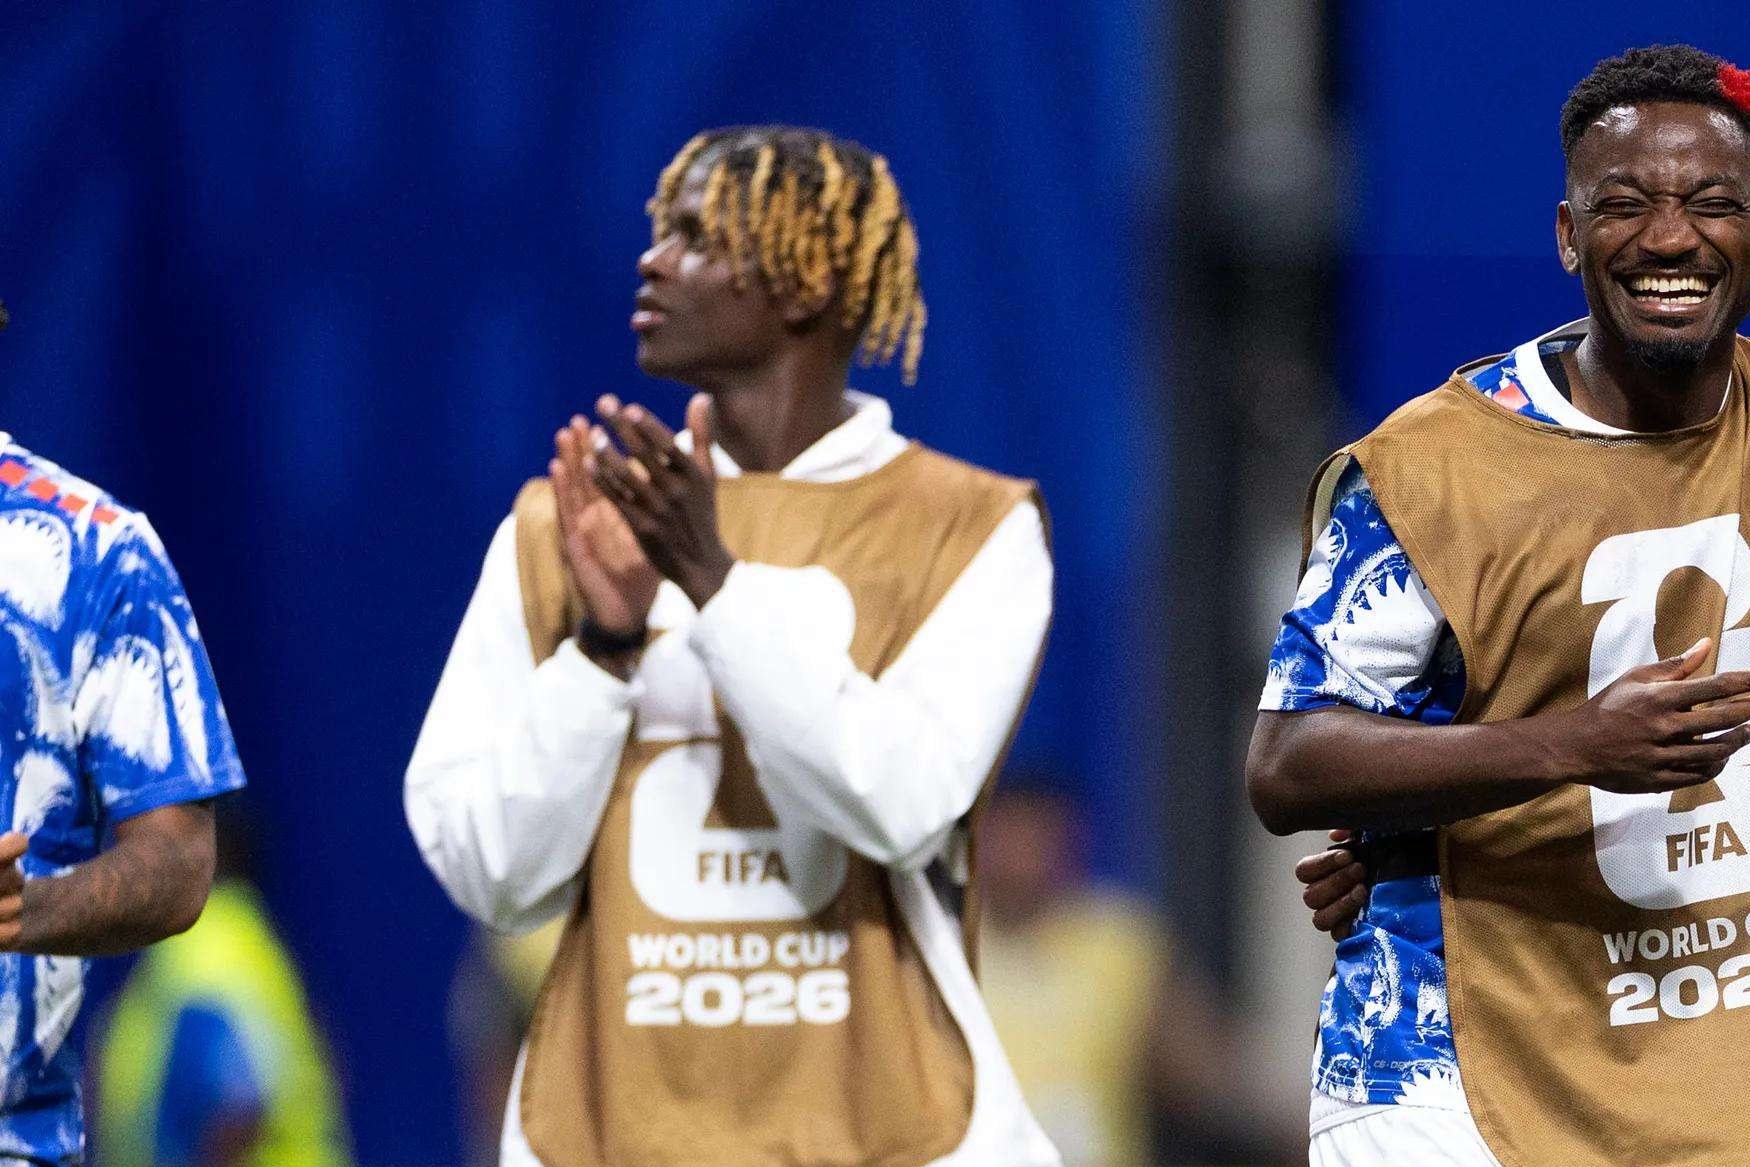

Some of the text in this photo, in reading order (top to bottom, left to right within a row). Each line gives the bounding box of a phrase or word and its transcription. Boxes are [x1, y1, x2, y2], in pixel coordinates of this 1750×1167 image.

[697, 848, 790, 885] FIFA
[1665, 820, 1748, 872] FIFA
[627, 932, 849, 968] WORLD CUP
[1603, 917, 1737, 964] WORLD
[625, 969, 851, 1026] 2026
